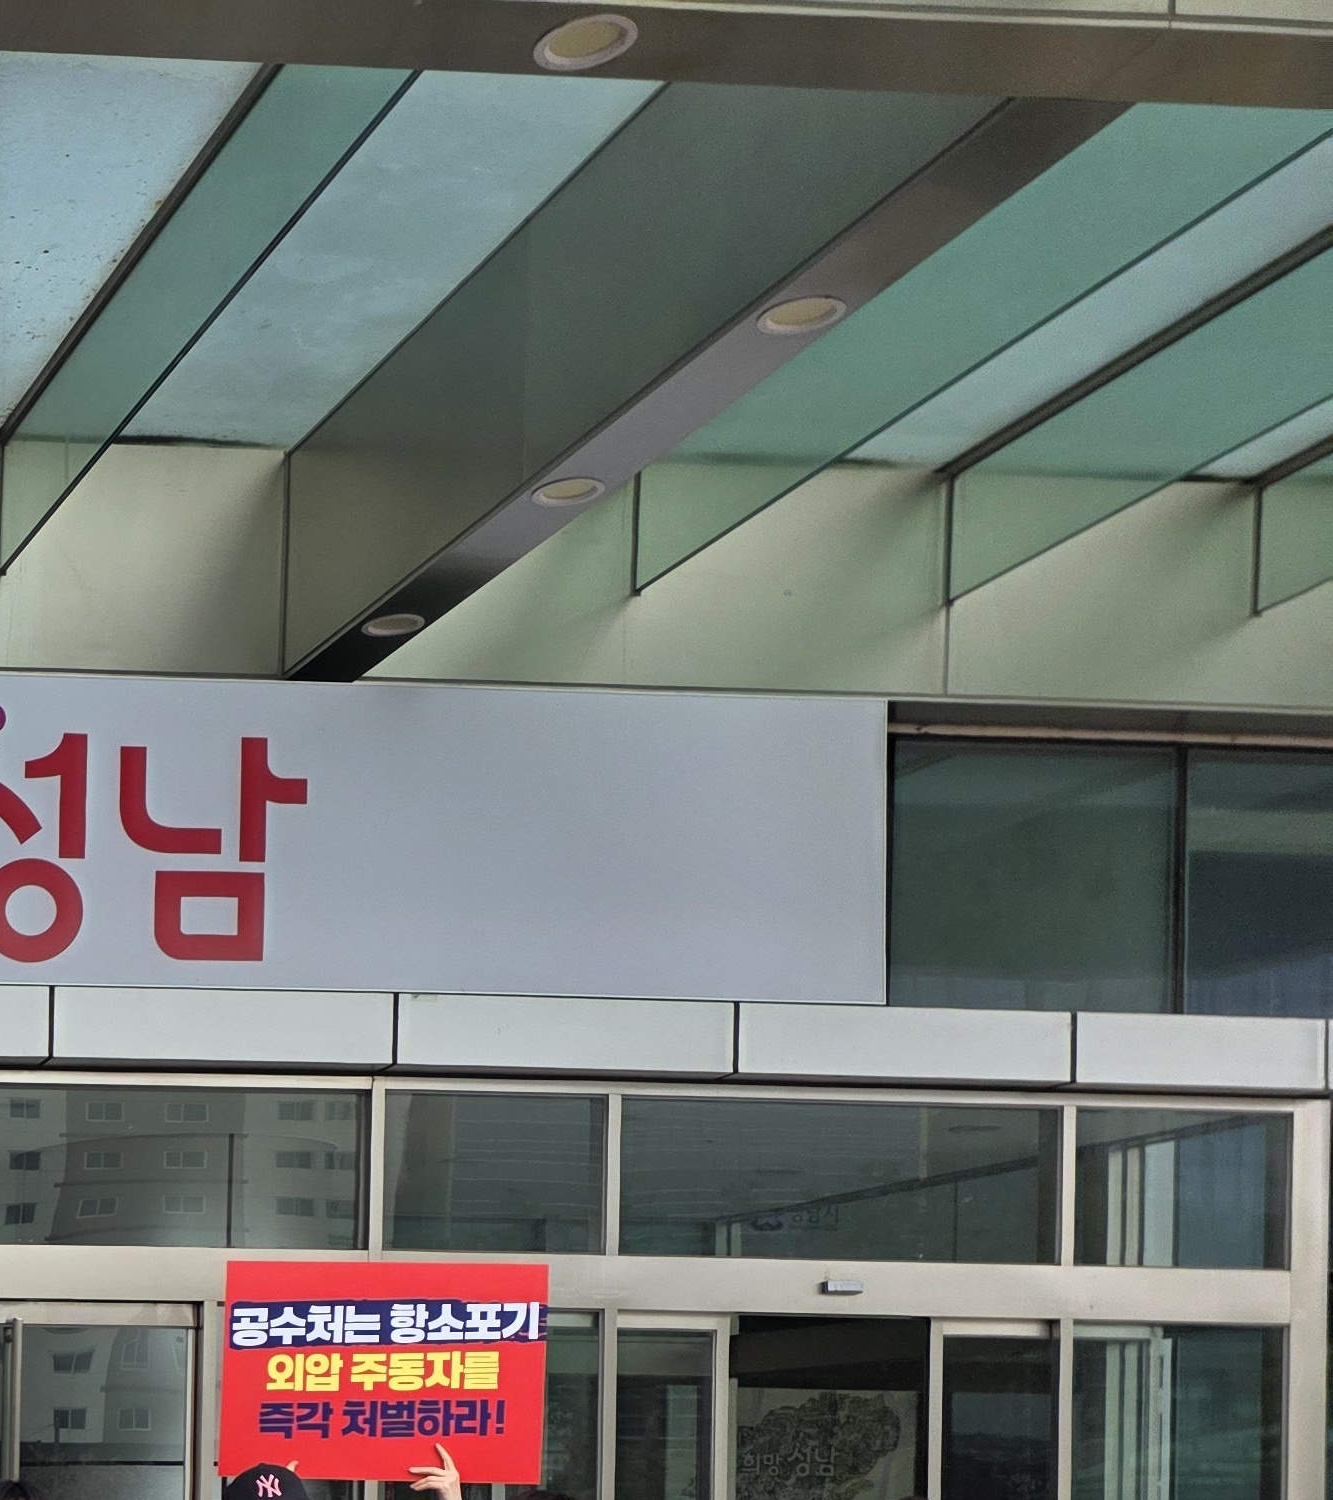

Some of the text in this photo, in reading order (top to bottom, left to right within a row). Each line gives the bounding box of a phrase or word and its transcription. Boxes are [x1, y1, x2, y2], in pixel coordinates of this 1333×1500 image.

[231, 1301, 541, 1345] 공수처는 항소포기
[265, 1351, 500, 1392] 외압 주동자를
[259, 1398, 504, 1439] 즉각 처벌하라!
[739, 1445, 840, 1478] 희망 성남
[255, 1473, 283, 1498] NY
